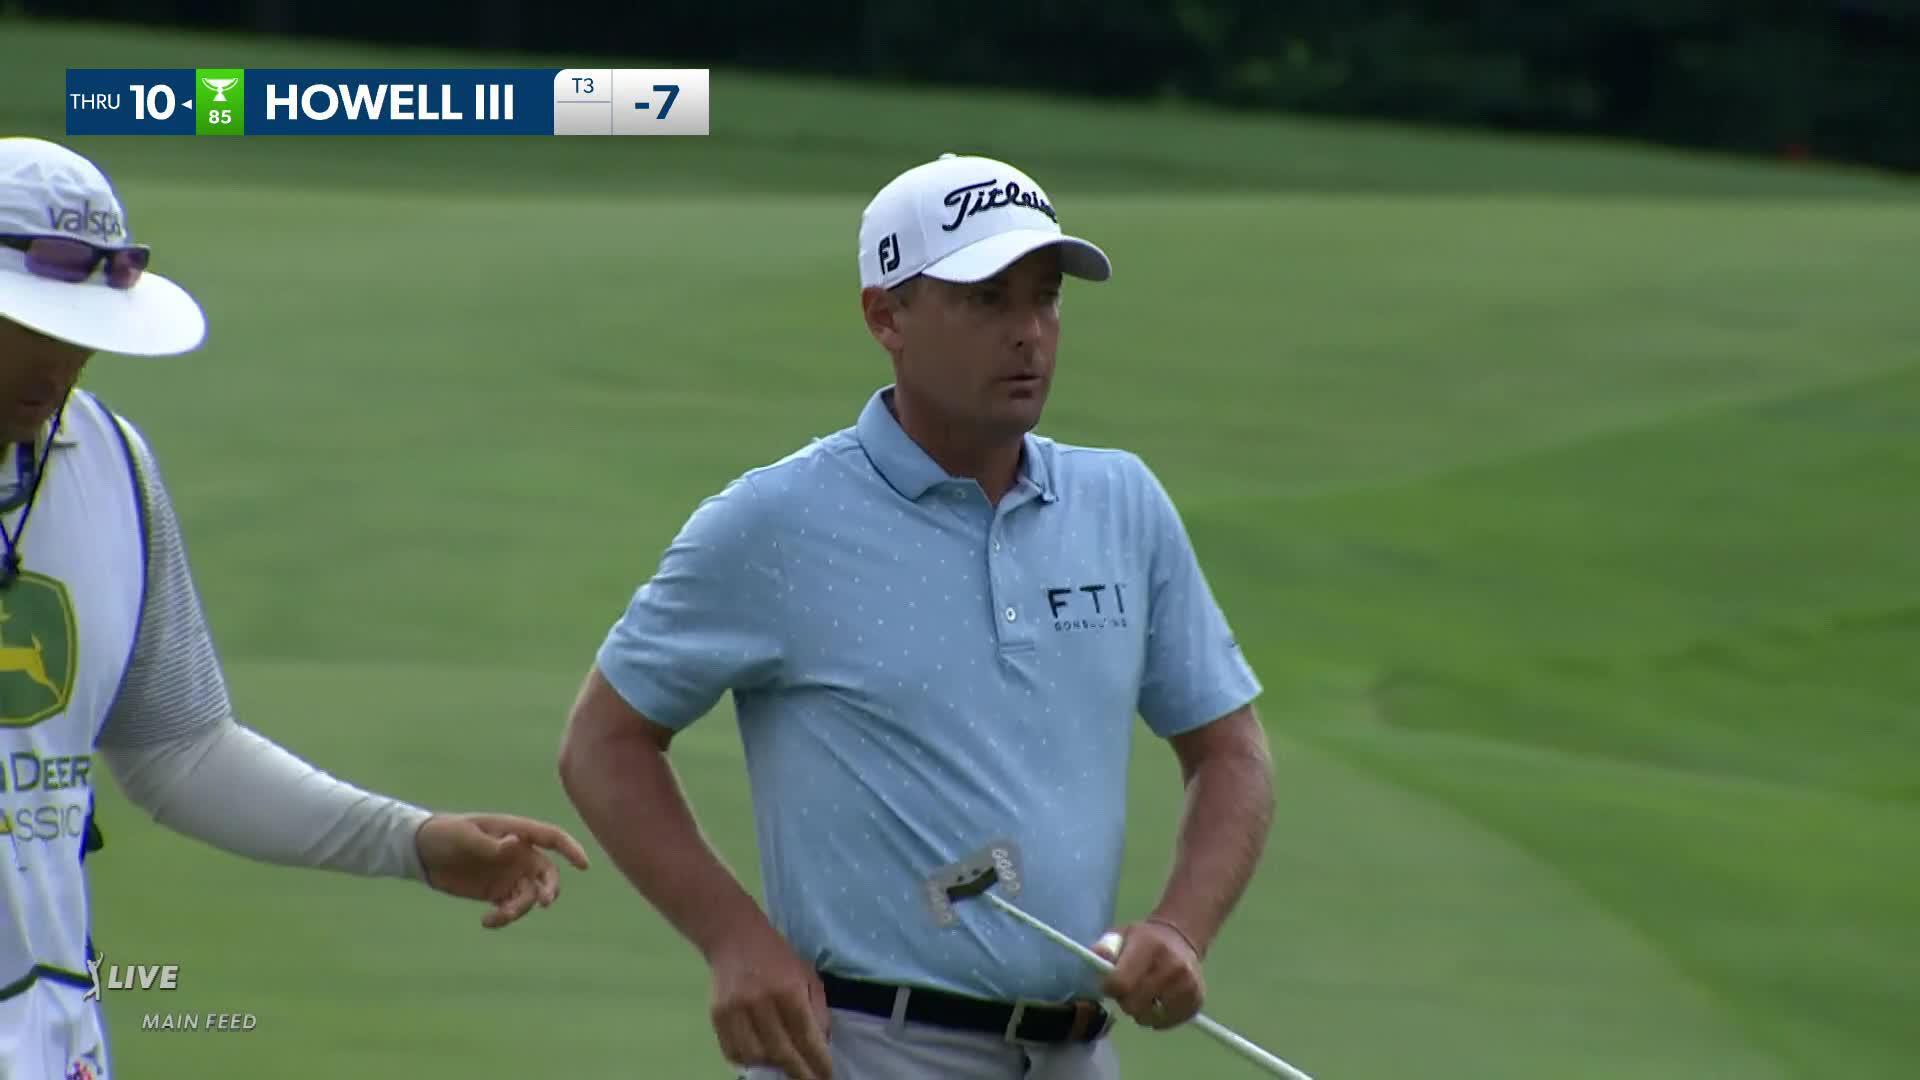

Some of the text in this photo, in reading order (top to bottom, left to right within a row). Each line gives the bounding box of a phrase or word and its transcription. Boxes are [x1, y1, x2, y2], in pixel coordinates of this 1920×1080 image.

[942, 179, 1057, 231] Titlei
[878, 232, 901, 275] FJ
[1047, 584, 1124, 618] FTI
